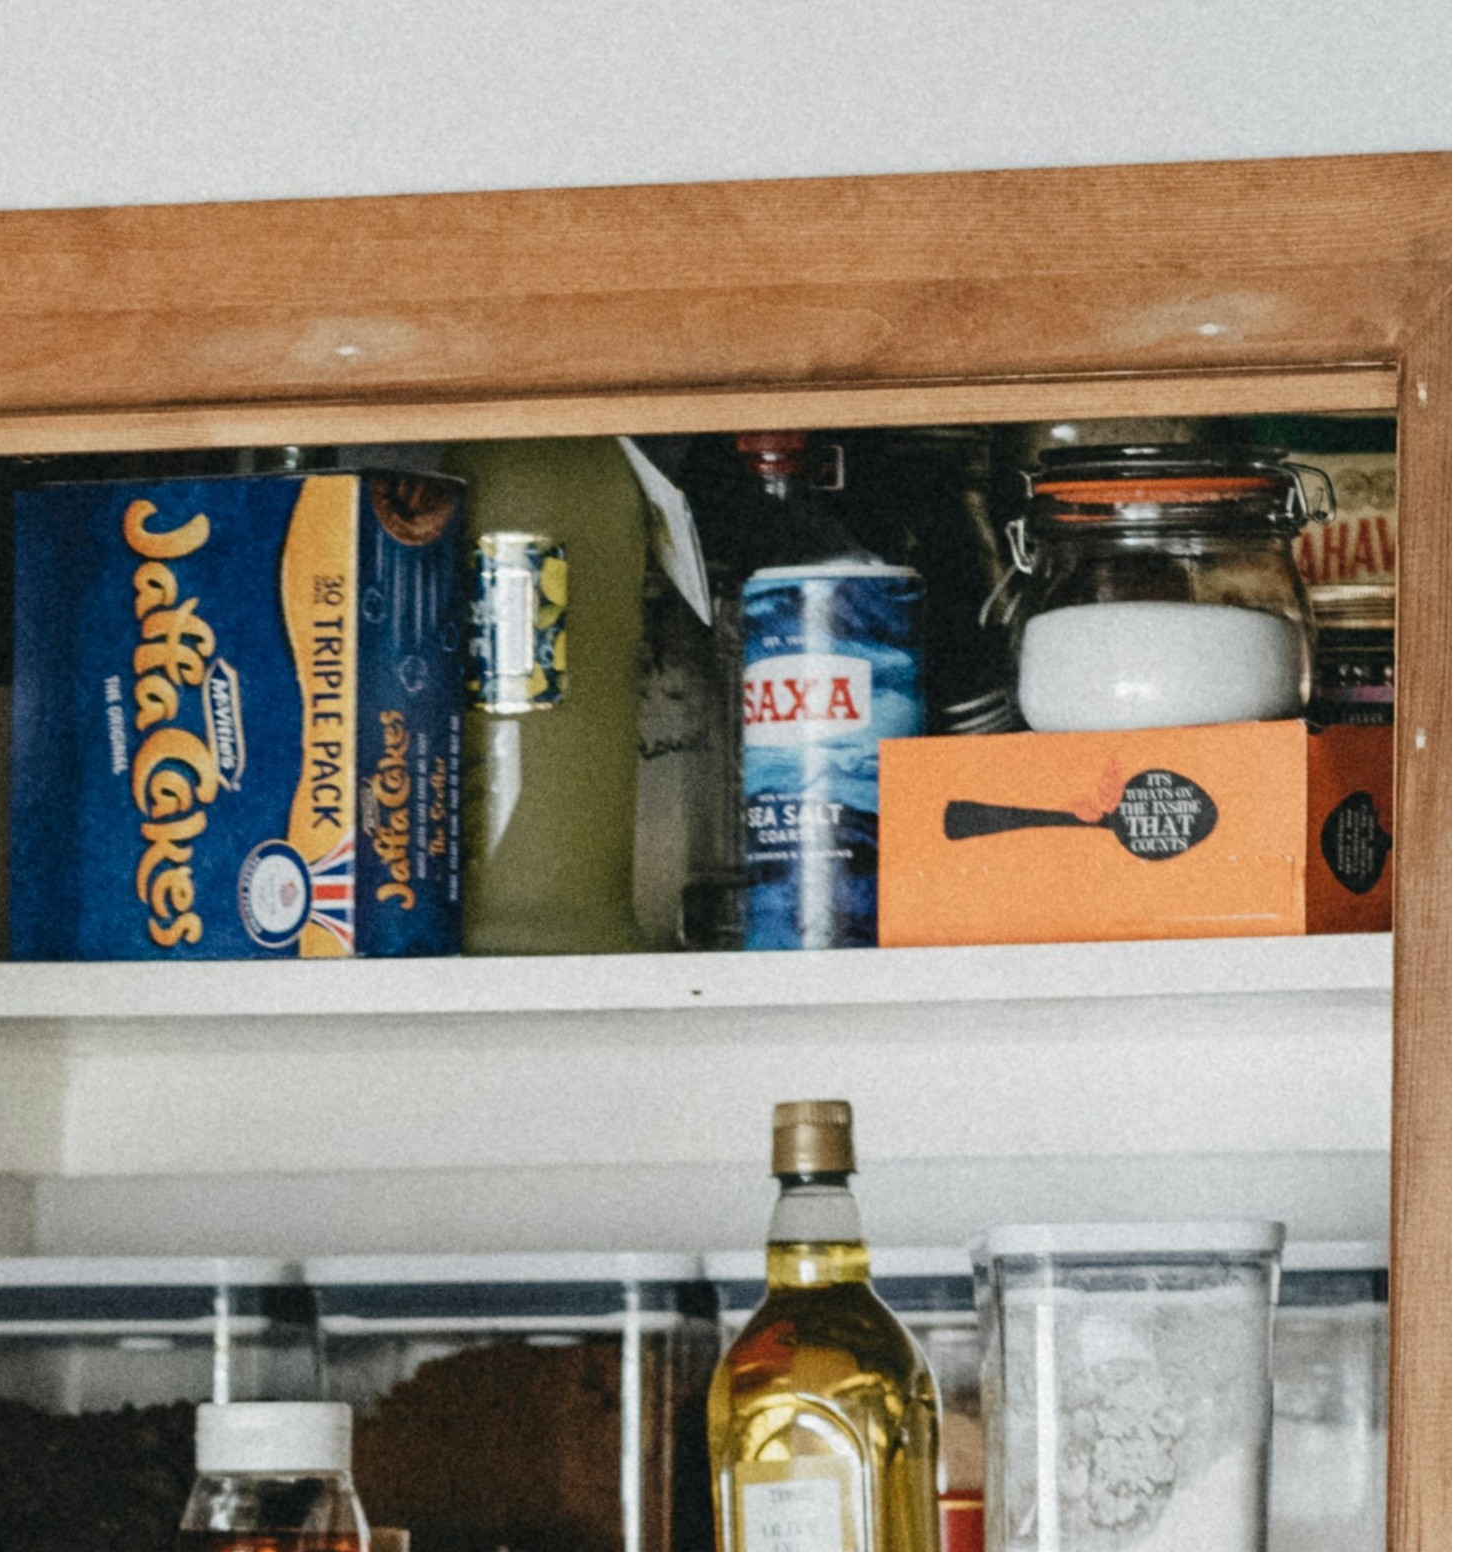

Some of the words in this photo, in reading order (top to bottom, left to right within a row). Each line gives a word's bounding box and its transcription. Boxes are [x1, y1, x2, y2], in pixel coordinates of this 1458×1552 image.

[122, 499, 216, 731] Jaffa
[312, 617, 343, 727] TRIPLE
[744, 676, 859, 725] SAXA
[312, 741, 343, 829] PACK
[371, 710, 410, 808] Cakes
[132, 728, 219, 947] Cakes
[371, 807, 416, 910] Jaffa
[747, 805, 778, 828] SEA
[782, 802, 844, 826] SALT
[1123, 813, 1195, 837] THAT
